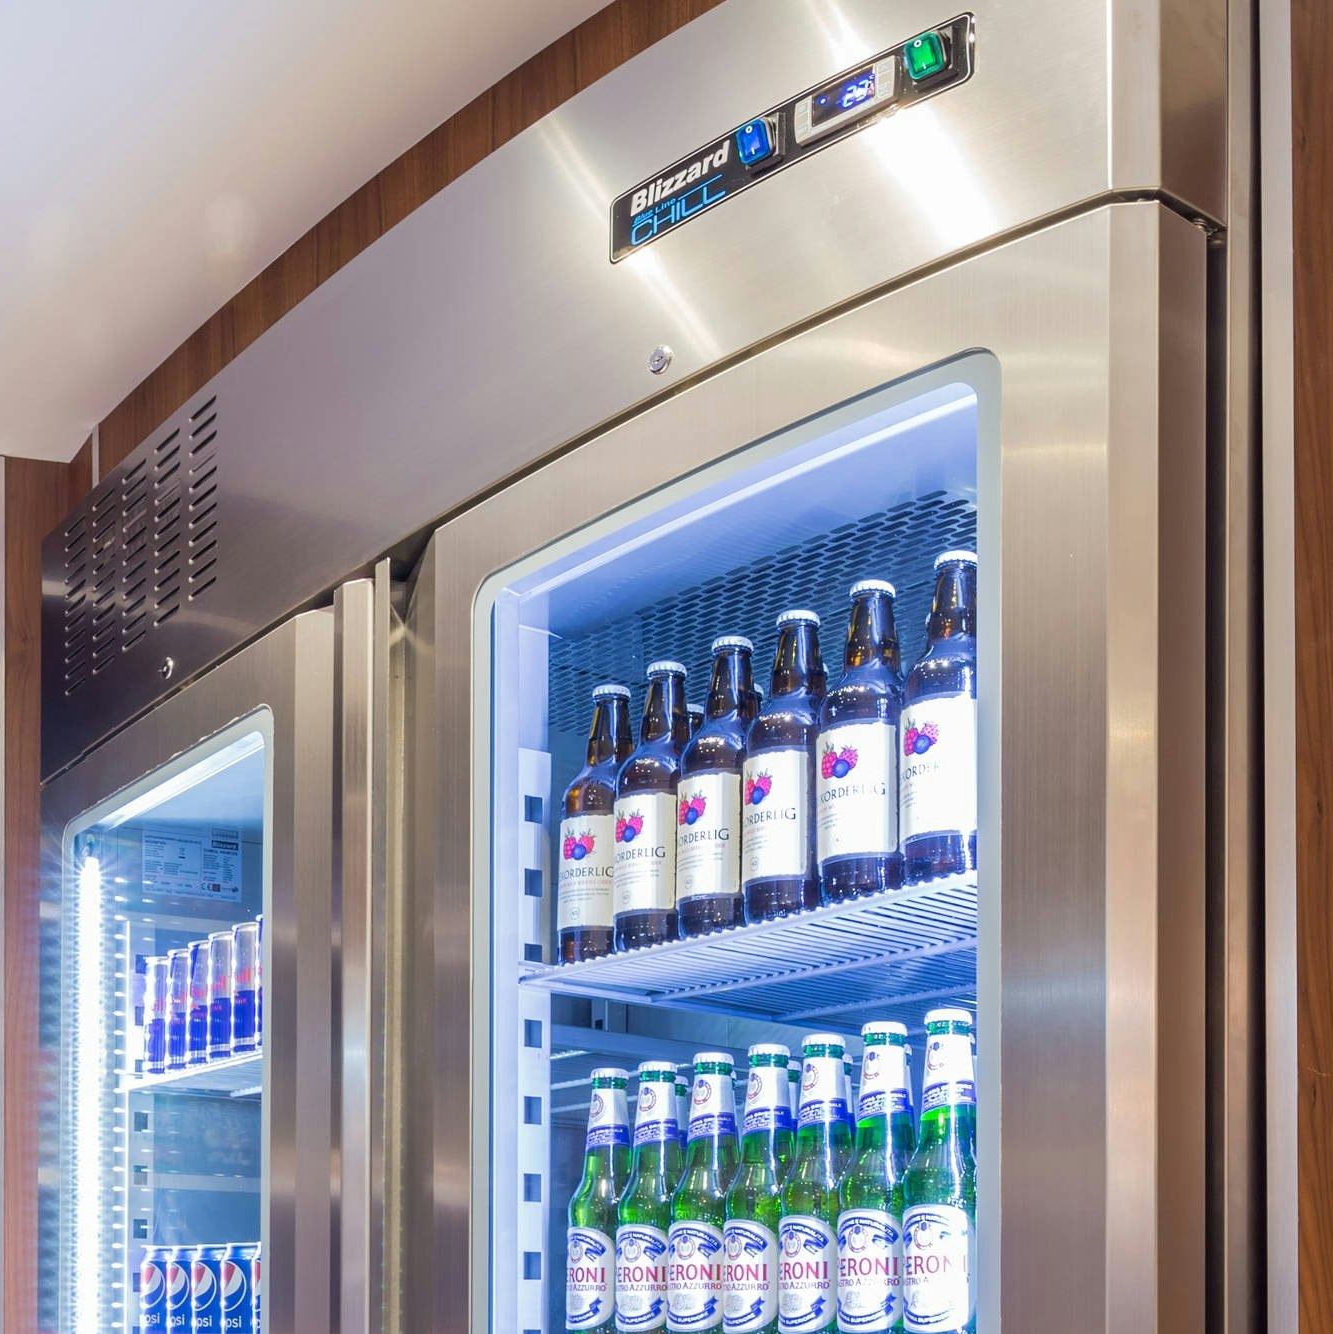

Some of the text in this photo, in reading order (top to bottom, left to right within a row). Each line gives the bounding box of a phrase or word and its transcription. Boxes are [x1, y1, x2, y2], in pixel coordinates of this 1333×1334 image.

[630, 140, 730, 216] Blizzard
[655, 198, 676, 213] Line
[631, 186, 726, 245] CHILL
[678, 828, 730, 847] ORDERLIG
[560, 866, 613, 880] KORDERLIG
[840, 1257, 899, 1276] ERONI
[225, 1316, 242, 1330] psi
